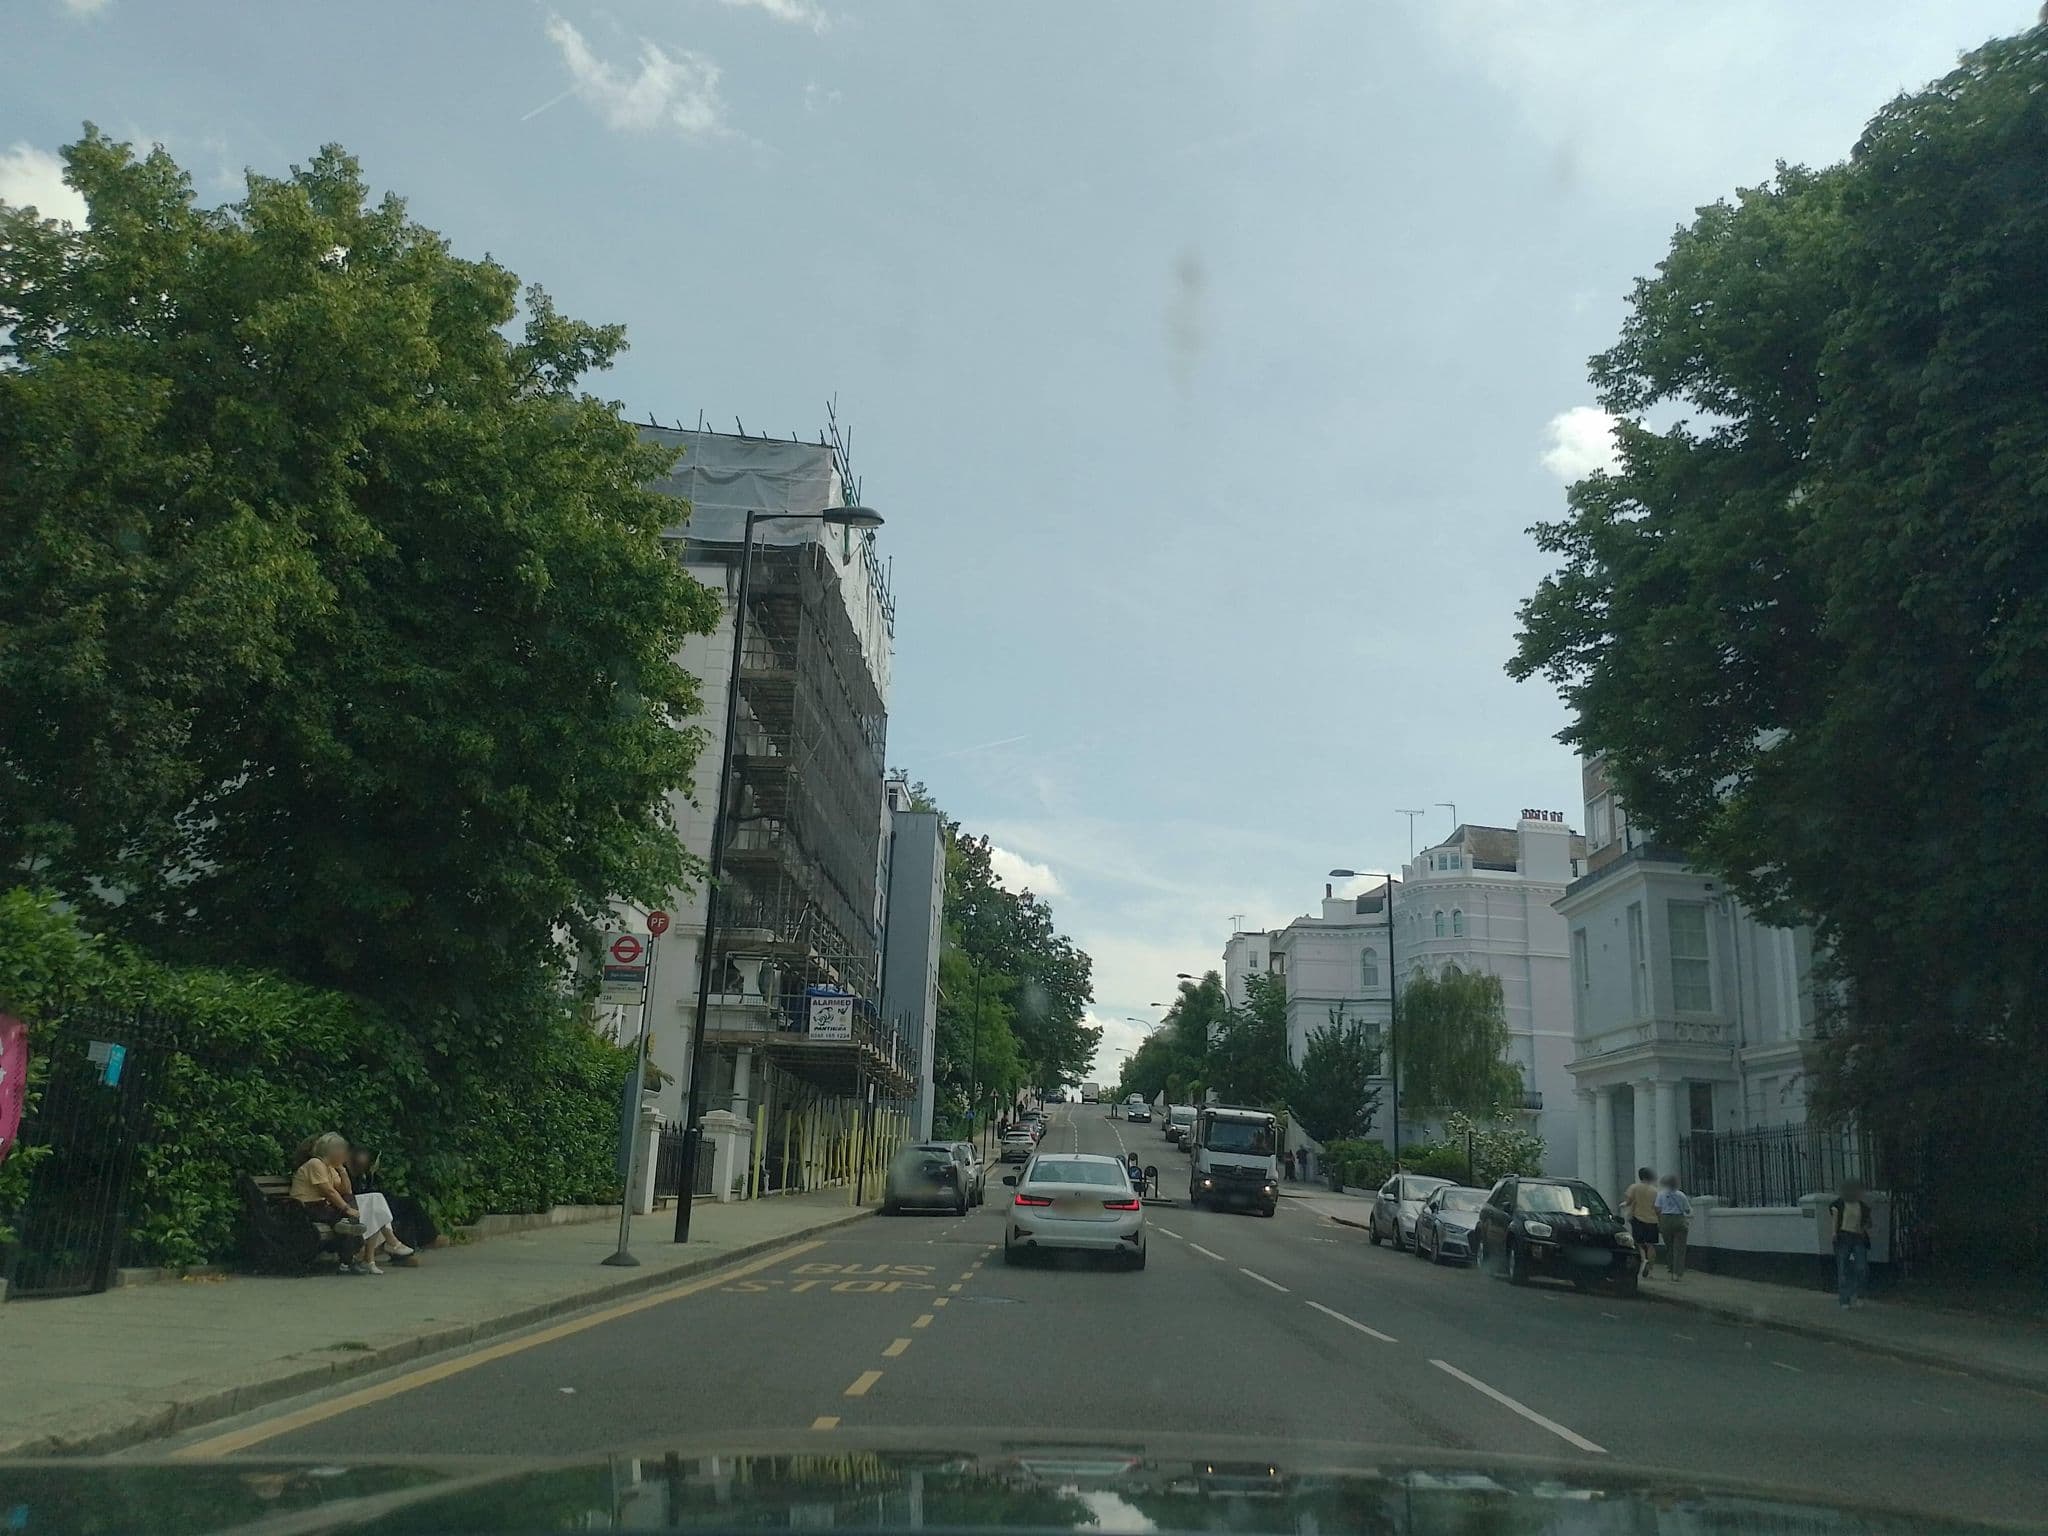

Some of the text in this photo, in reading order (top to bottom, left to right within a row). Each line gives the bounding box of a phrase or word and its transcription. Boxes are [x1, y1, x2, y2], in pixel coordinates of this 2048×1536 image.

[651, 917, 665, 927] PF
[791, 1263, 936, 1276] BUS
[721, 1279, 936, 1292] STOP
